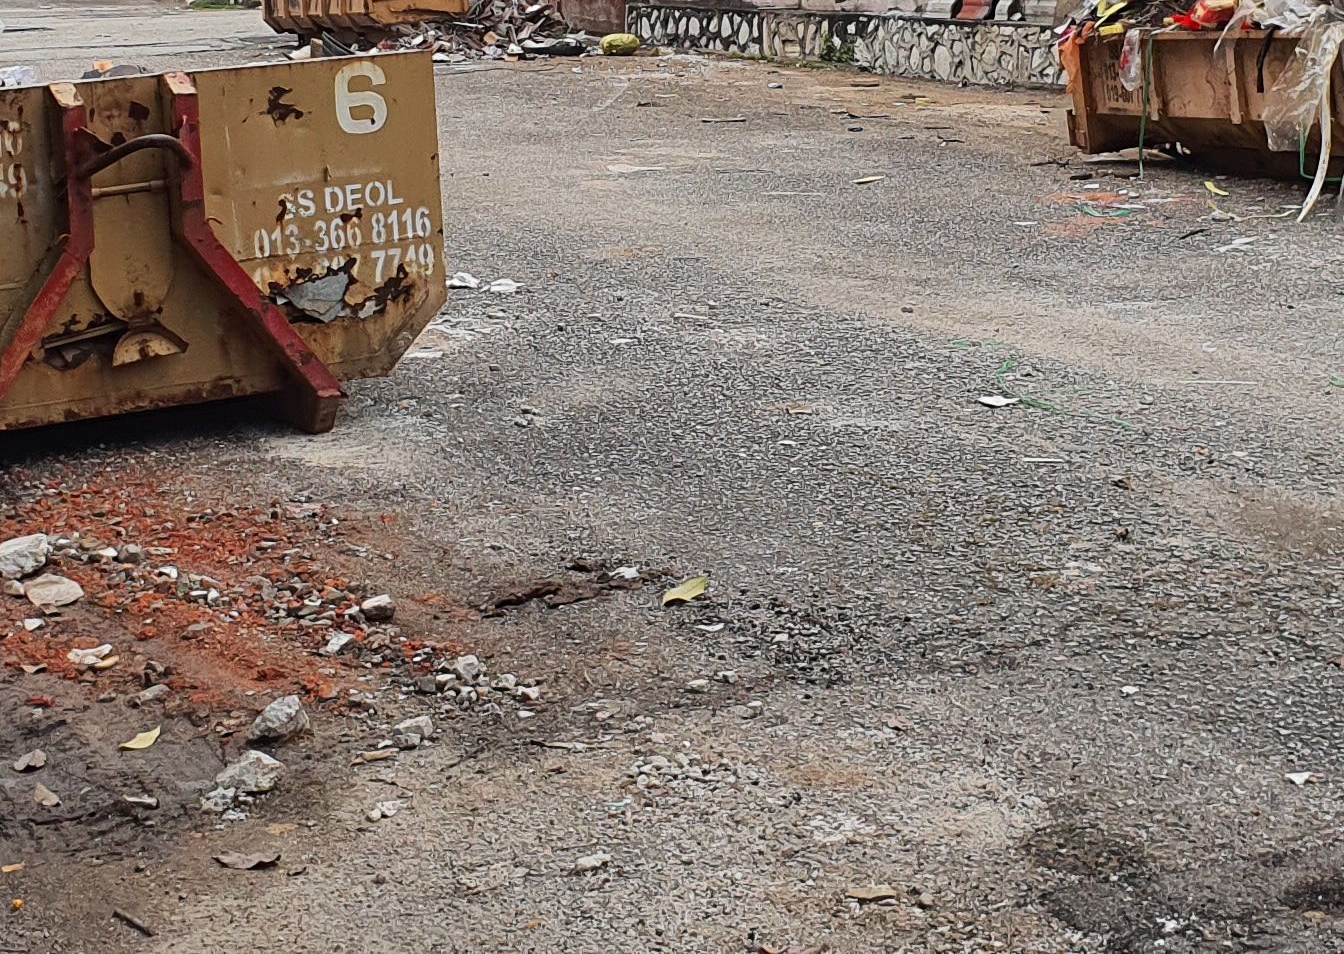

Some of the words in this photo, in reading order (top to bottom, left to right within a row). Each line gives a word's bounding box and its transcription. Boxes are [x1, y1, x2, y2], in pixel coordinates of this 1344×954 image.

[334, 60, 388, 135] 6
[323, 180, 404, 214] DEOL
[254, 216, 362, 259] 013-366
[371, 206, 432, 244] 8116
